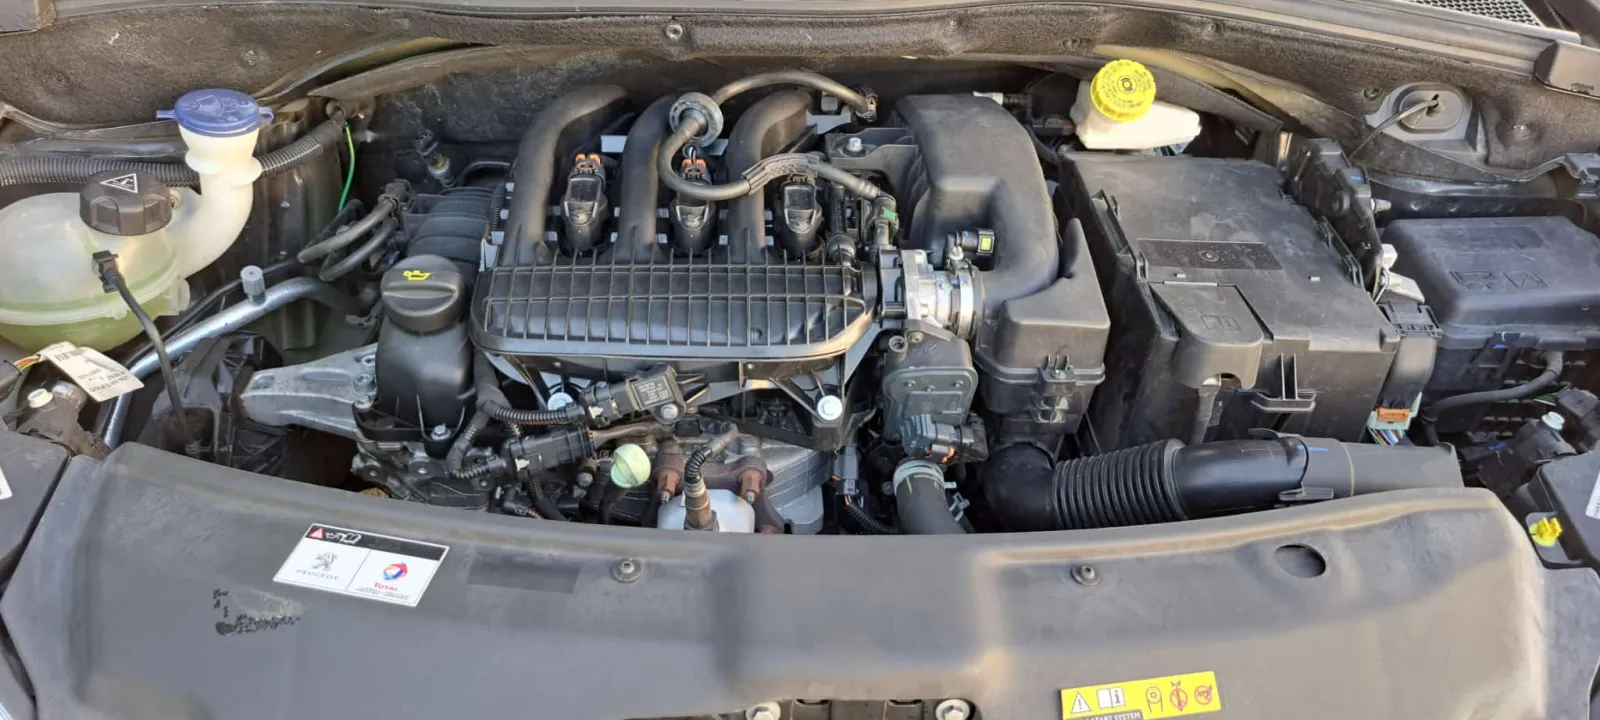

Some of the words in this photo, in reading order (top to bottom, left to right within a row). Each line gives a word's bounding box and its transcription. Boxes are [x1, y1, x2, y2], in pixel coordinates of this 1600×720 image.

[296, 570, 338, 581] PEUGEOT
[374, 582, 398, 592] TOTAL
[1114, 711, 1142, 720] SYSTEM
